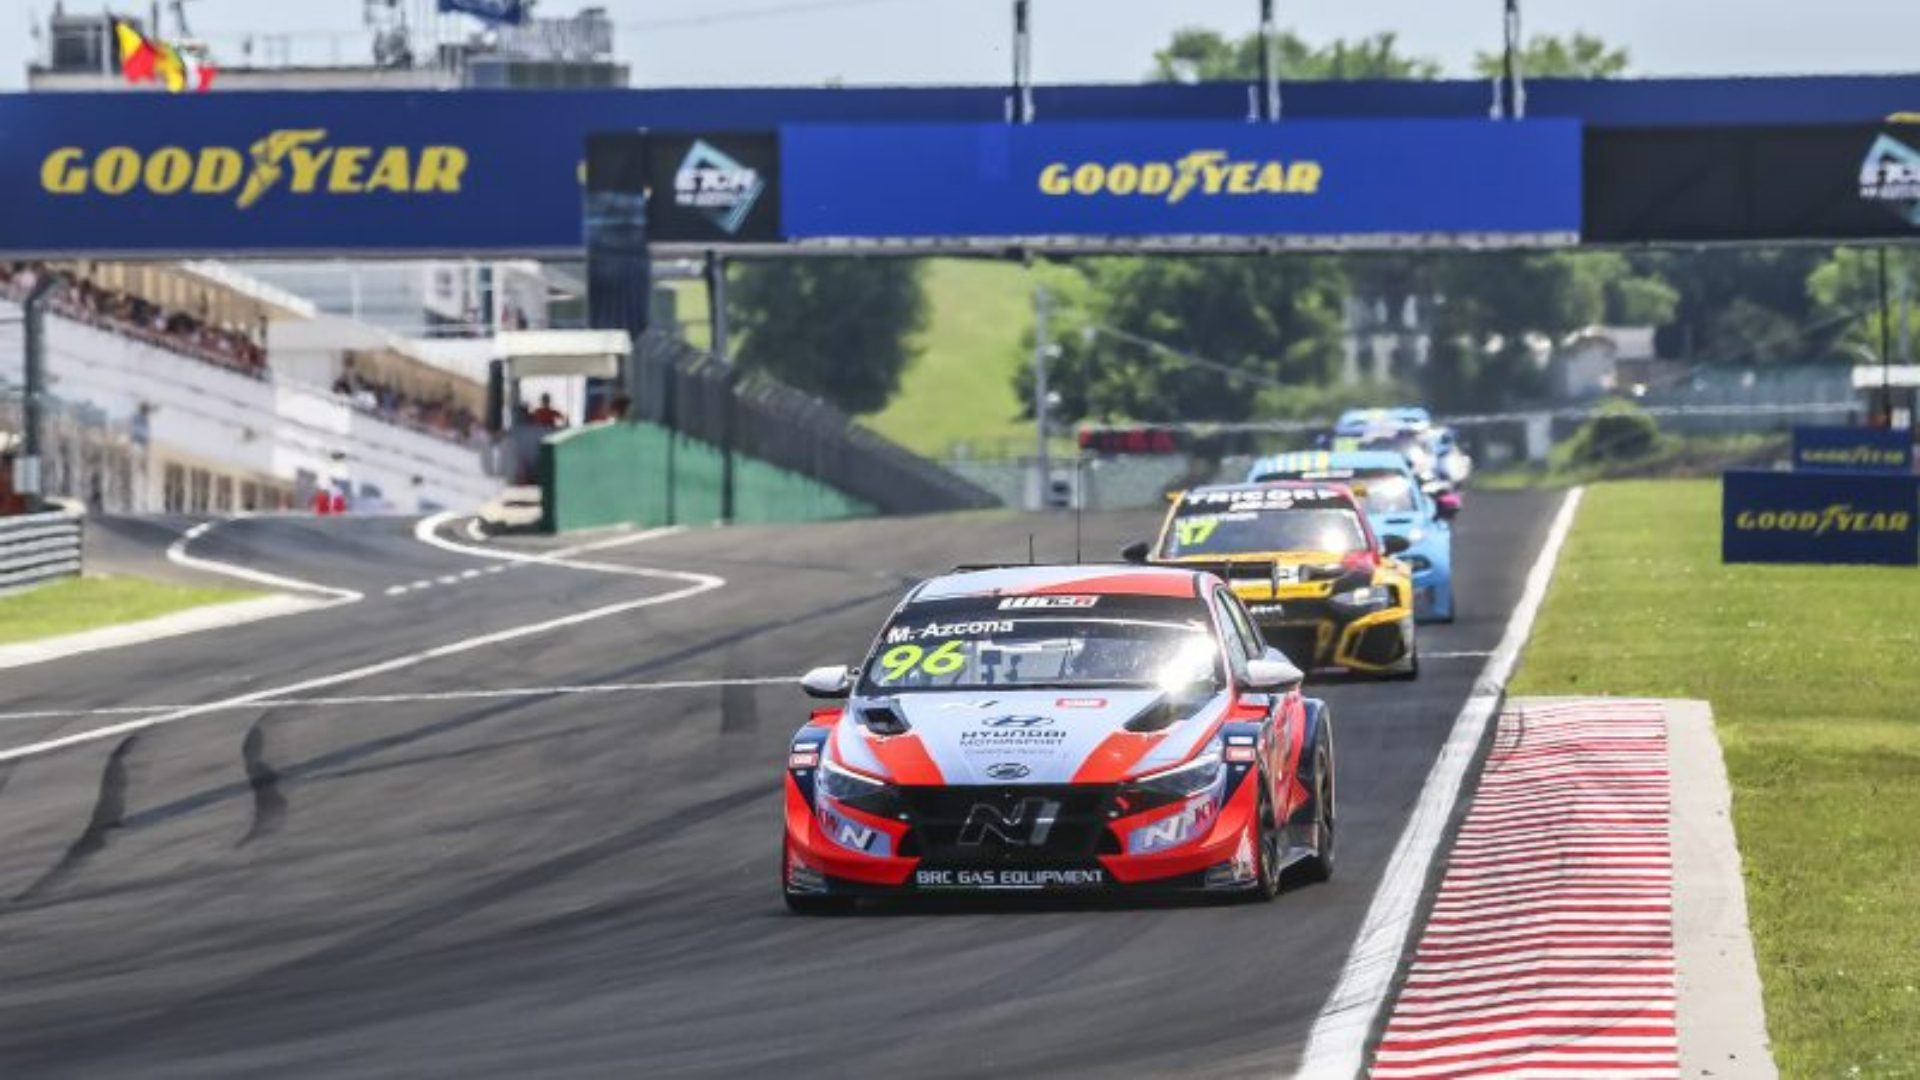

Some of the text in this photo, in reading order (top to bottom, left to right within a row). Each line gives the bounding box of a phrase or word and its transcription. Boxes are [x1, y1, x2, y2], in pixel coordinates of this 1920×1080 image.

[40, 134, 468, 203] GOODYEAR
[1038, 153, 1322, 200] GOODYEAR
[1735, 506, 1911, 533] GOODYEAR
[887, 620, 1014, 644] M. Azcona
[880, 640, 967, 681] 96
[961, 729, 1067, 740] HYUNDAI
[915, 869, 1103, 884] BRC GAS EQUIPMENT
